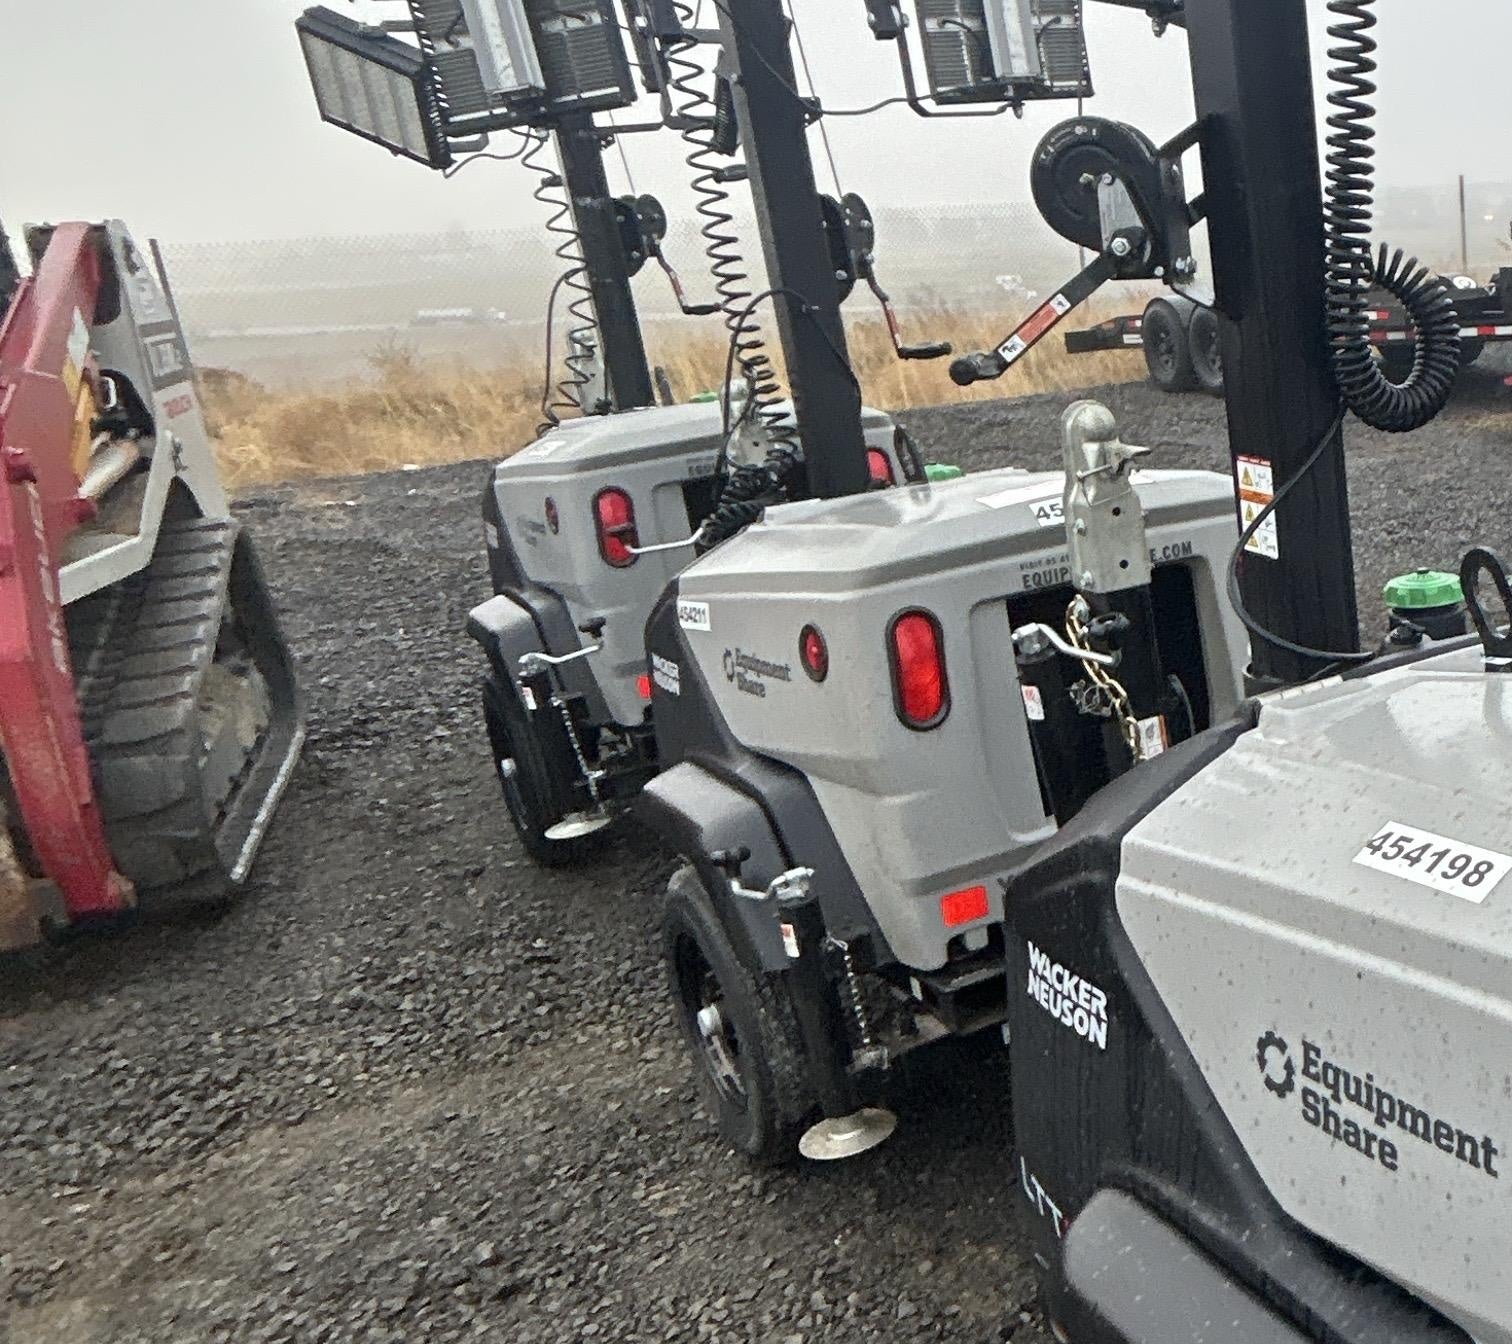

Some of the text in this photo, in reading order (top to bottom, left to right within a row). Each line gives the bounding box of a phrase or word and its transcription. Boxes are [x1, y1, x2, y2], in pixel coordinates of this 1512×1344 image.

[1366, 831, 1495, 888] 454198
[1027, 940, 1108, 1022] WACKER
[1027, 968, 1107, 1050] NEUSON
[1301, 1039, 1498, 1179] Equipment
[1301, 1086, 1399, 1172] Share
